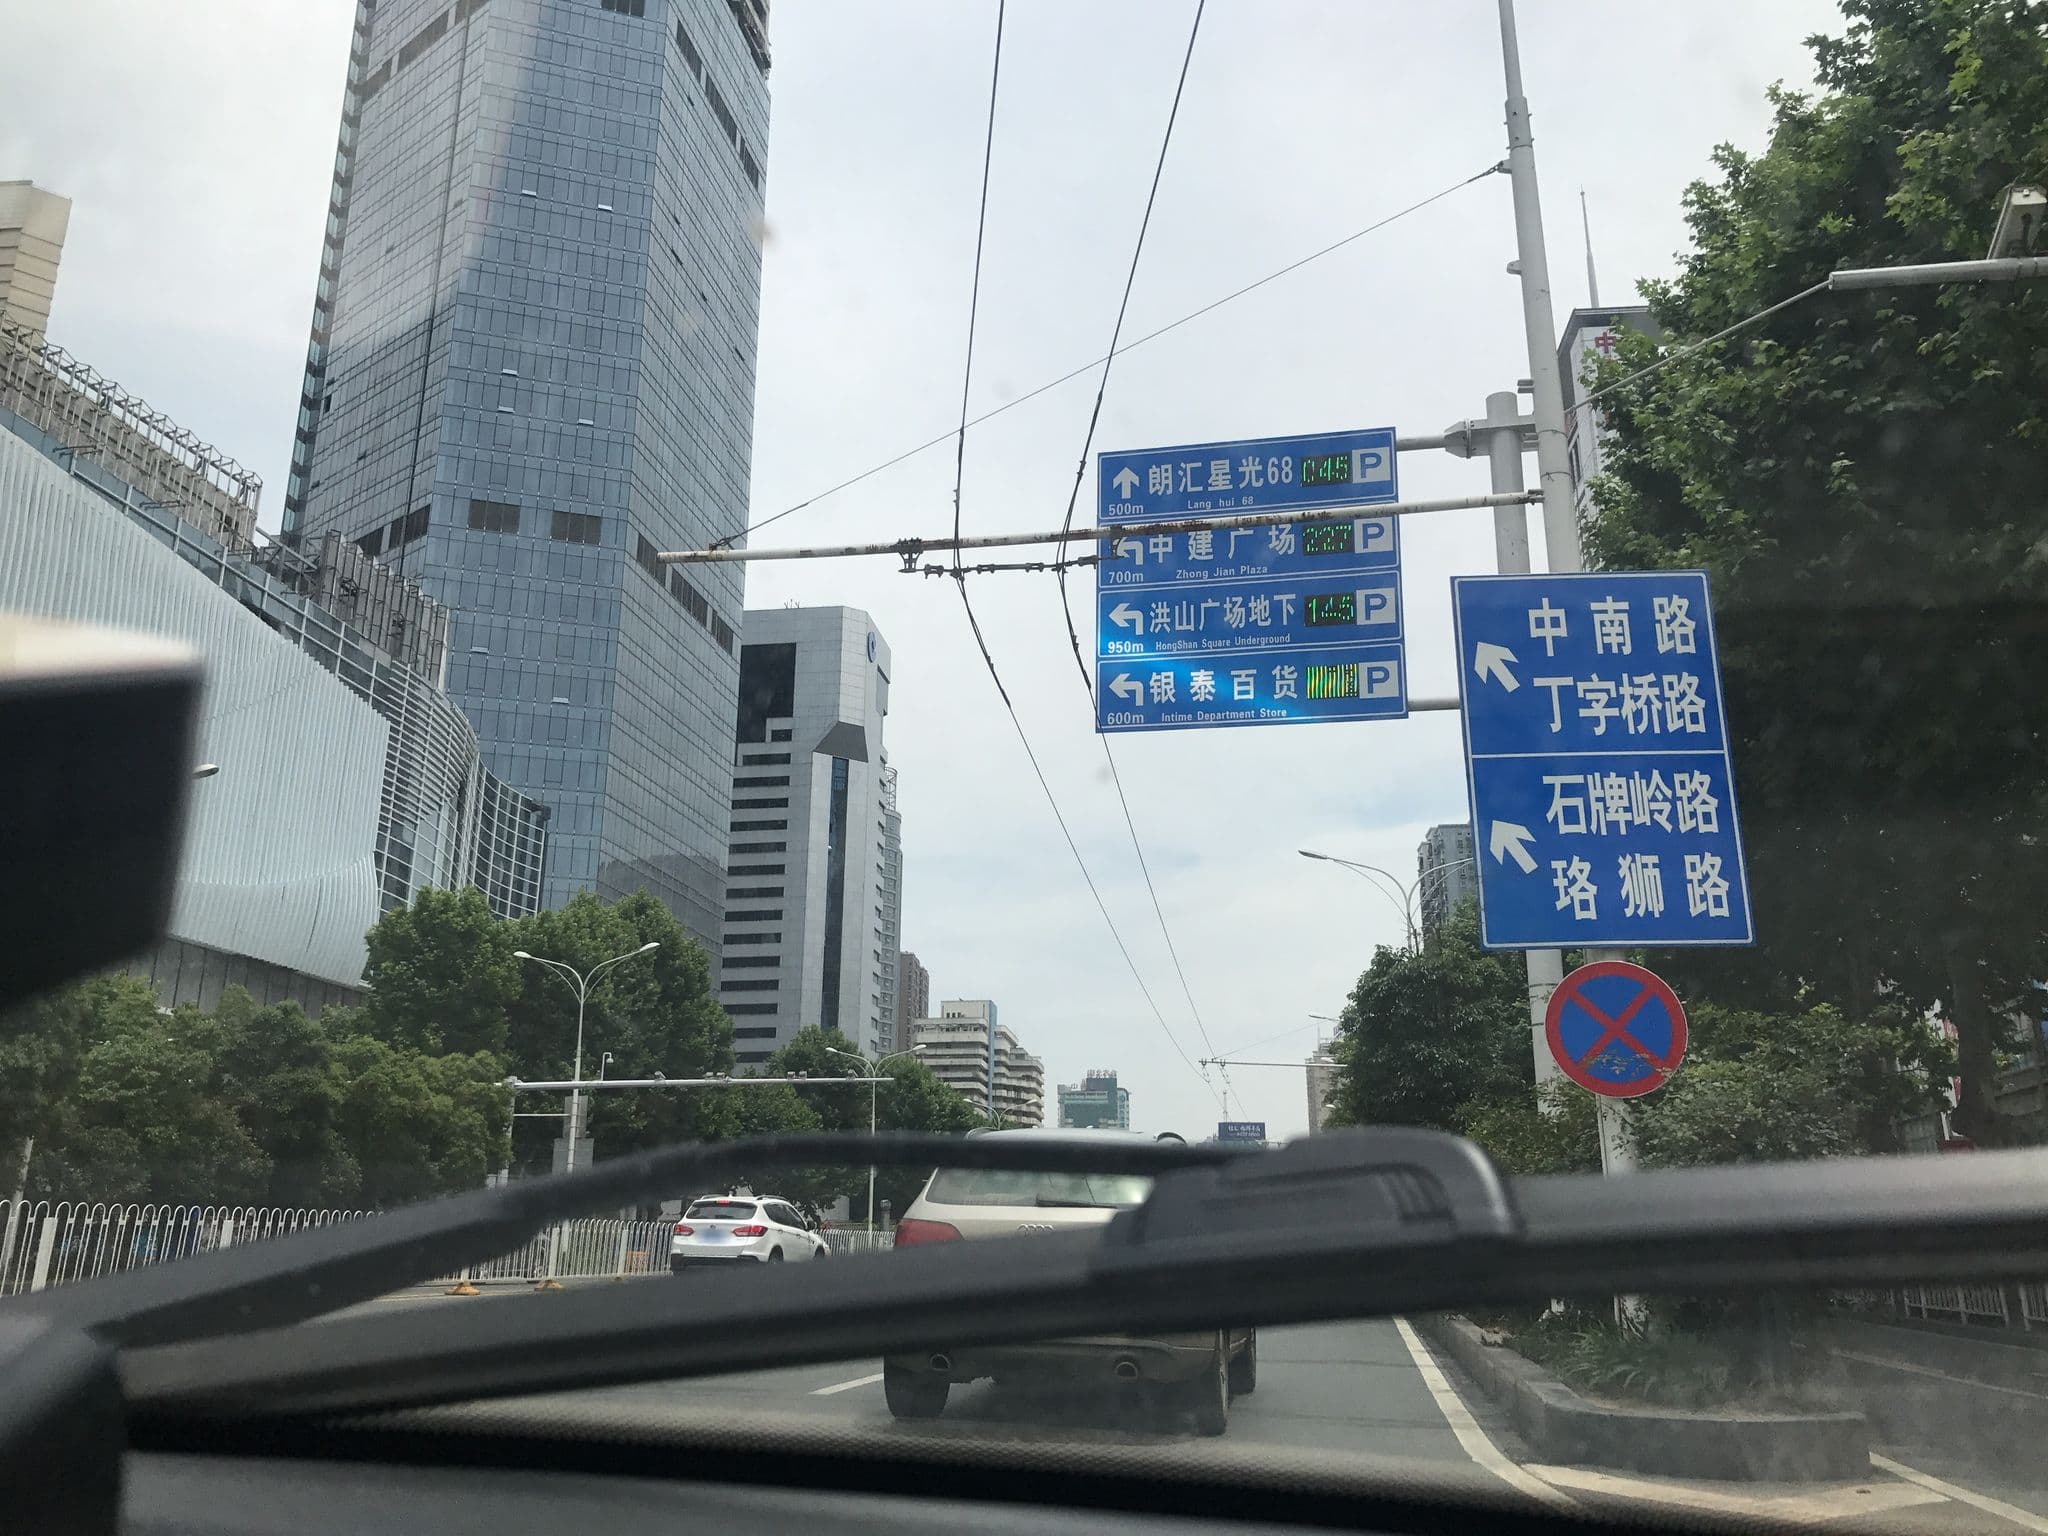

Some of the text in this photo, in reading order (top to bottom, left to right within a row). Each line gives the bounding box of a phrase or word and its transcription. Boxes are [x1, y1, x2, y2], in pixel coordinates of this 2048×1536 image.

[1149, 456, 1292, 495] 朗汇星光68
[1360, 453, 1382, 478] P
[1109, 503, 1144, 515] 500m
[1188, 496, 1254, 510] Lang hui 68
[1149, 524, 1295, 563] 中建广场
[1363, 523, 1384, 549] P
[1109, 571, 1144, 583] 700m
[1176, 565, 1267, 580] Zhong Jian Plaza
[1149, 594, 1296, 633] 洪山广场地下
[1365, 594, 1386, 620] P
[1528, 595, 1697, 656] 中南路
[1107, 641, 1144, 653] 950m
[1156, 634, 1290, 651] HongShan Square Underground
[1149, 665, 1298, 704] 银泰百货
[1367, 667, 1389, 694] P
[1161, 708, 1287, 722] Intime Department Store
[1533, 672, 1707, 735] 丁字桥路
[1107, 712, 1144, 725] 600m
[1542, 769, 1719, 836] 石牌岭路
[1551, 852, 1730, 920] 珞狮路
